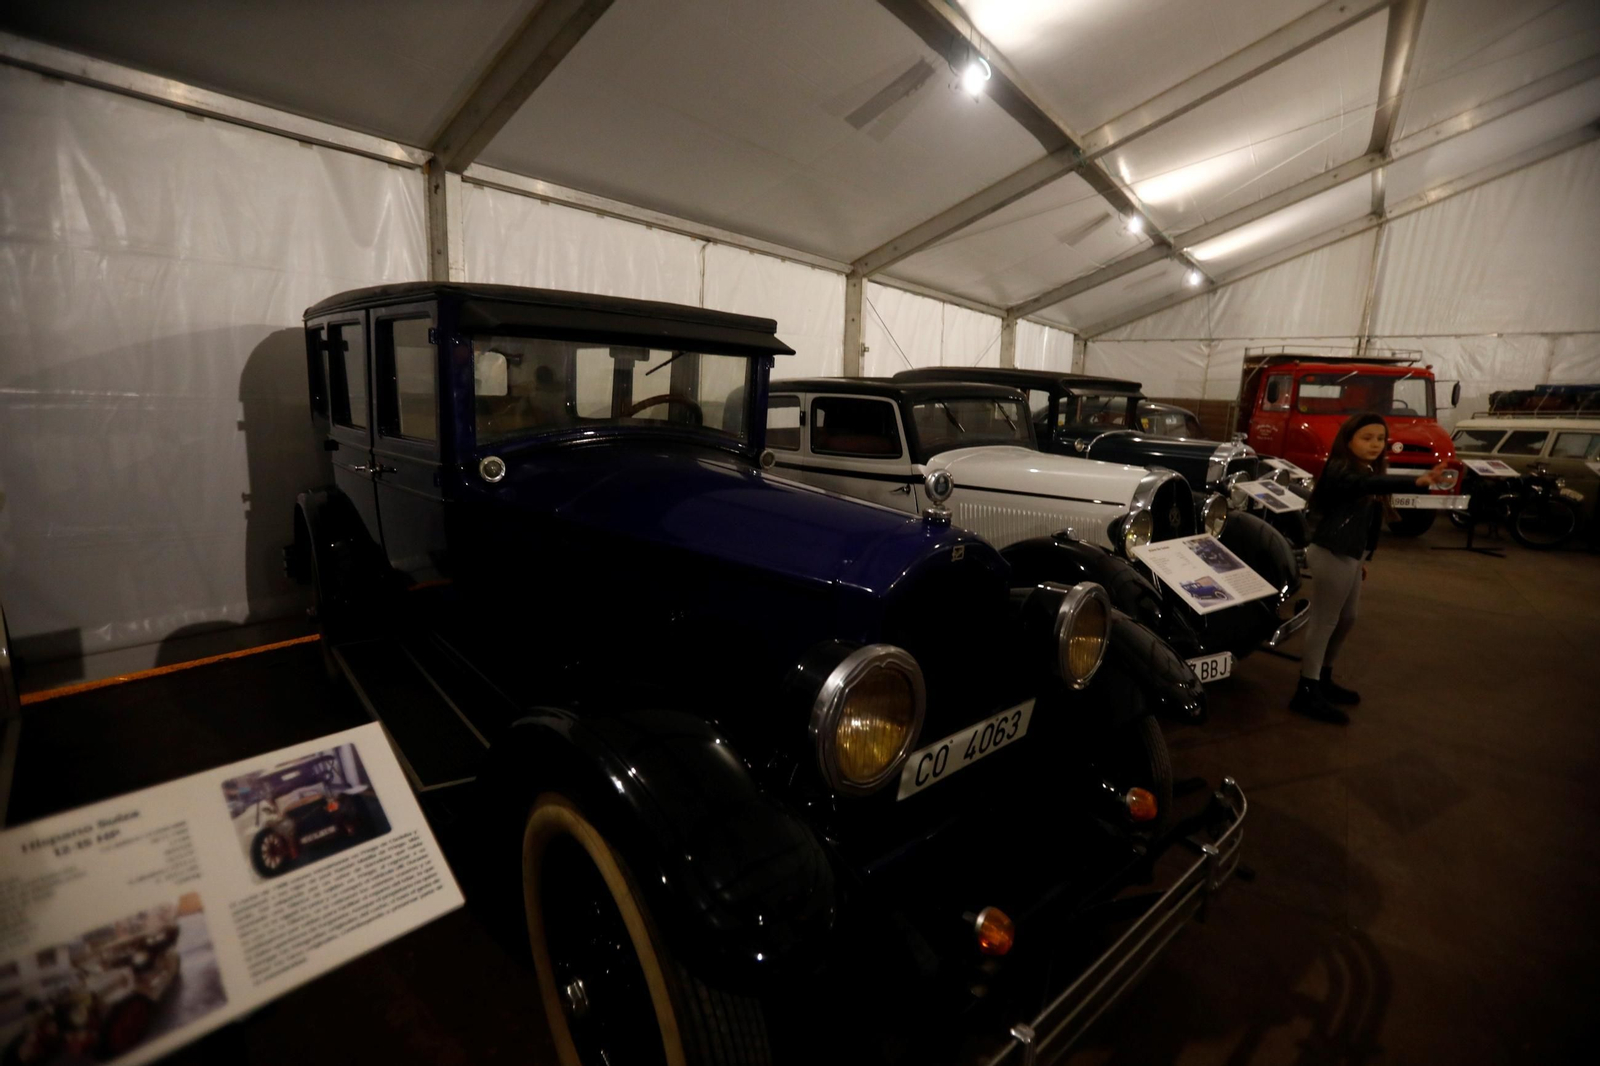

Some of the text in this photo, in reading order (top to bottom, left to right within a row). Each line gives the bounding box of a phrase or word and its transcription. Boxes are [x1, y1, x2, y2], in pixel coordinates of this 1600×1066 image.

[1201, 656, 1228, 680] BBJ
[915, 710, 1023, 787] CO 4063
